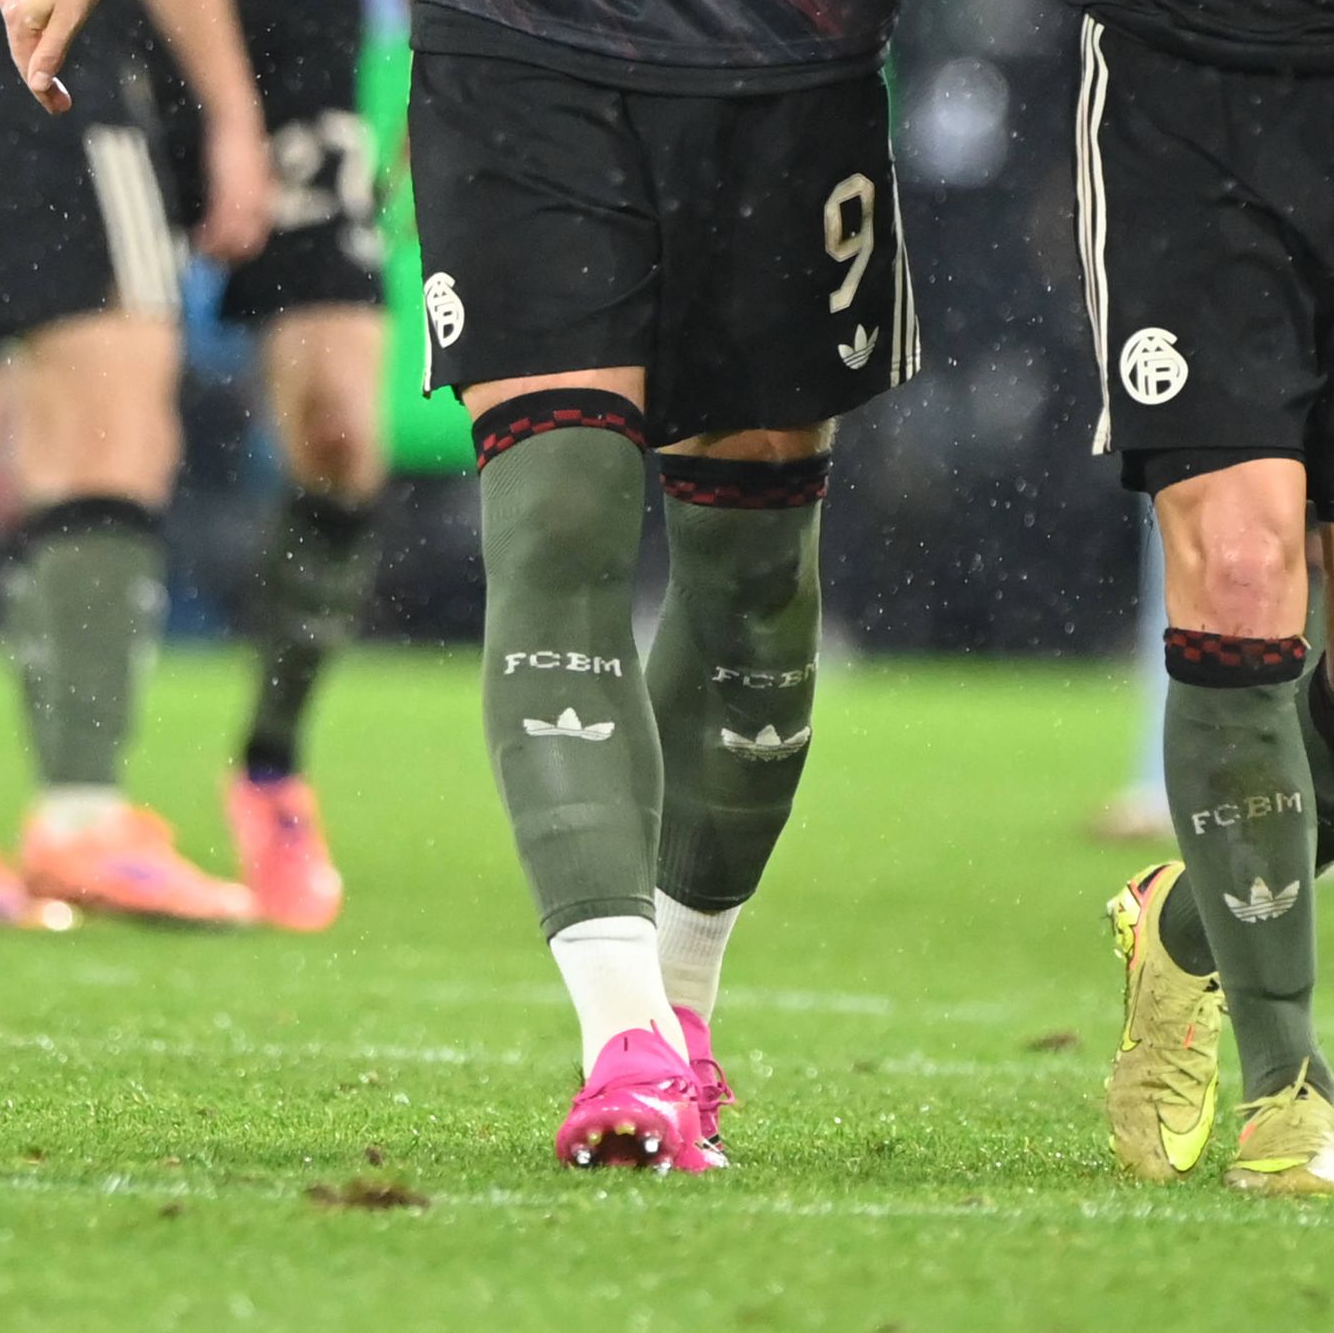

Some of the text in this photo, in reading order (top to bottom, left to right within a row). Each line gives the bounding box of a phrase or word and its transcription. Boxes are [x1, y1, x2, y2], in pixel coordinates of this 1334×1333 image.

[824, 172, 875, 314] 9
[503, 650, 623, 678] FCBM
[1191, 791, 1303, 835] FCBM
